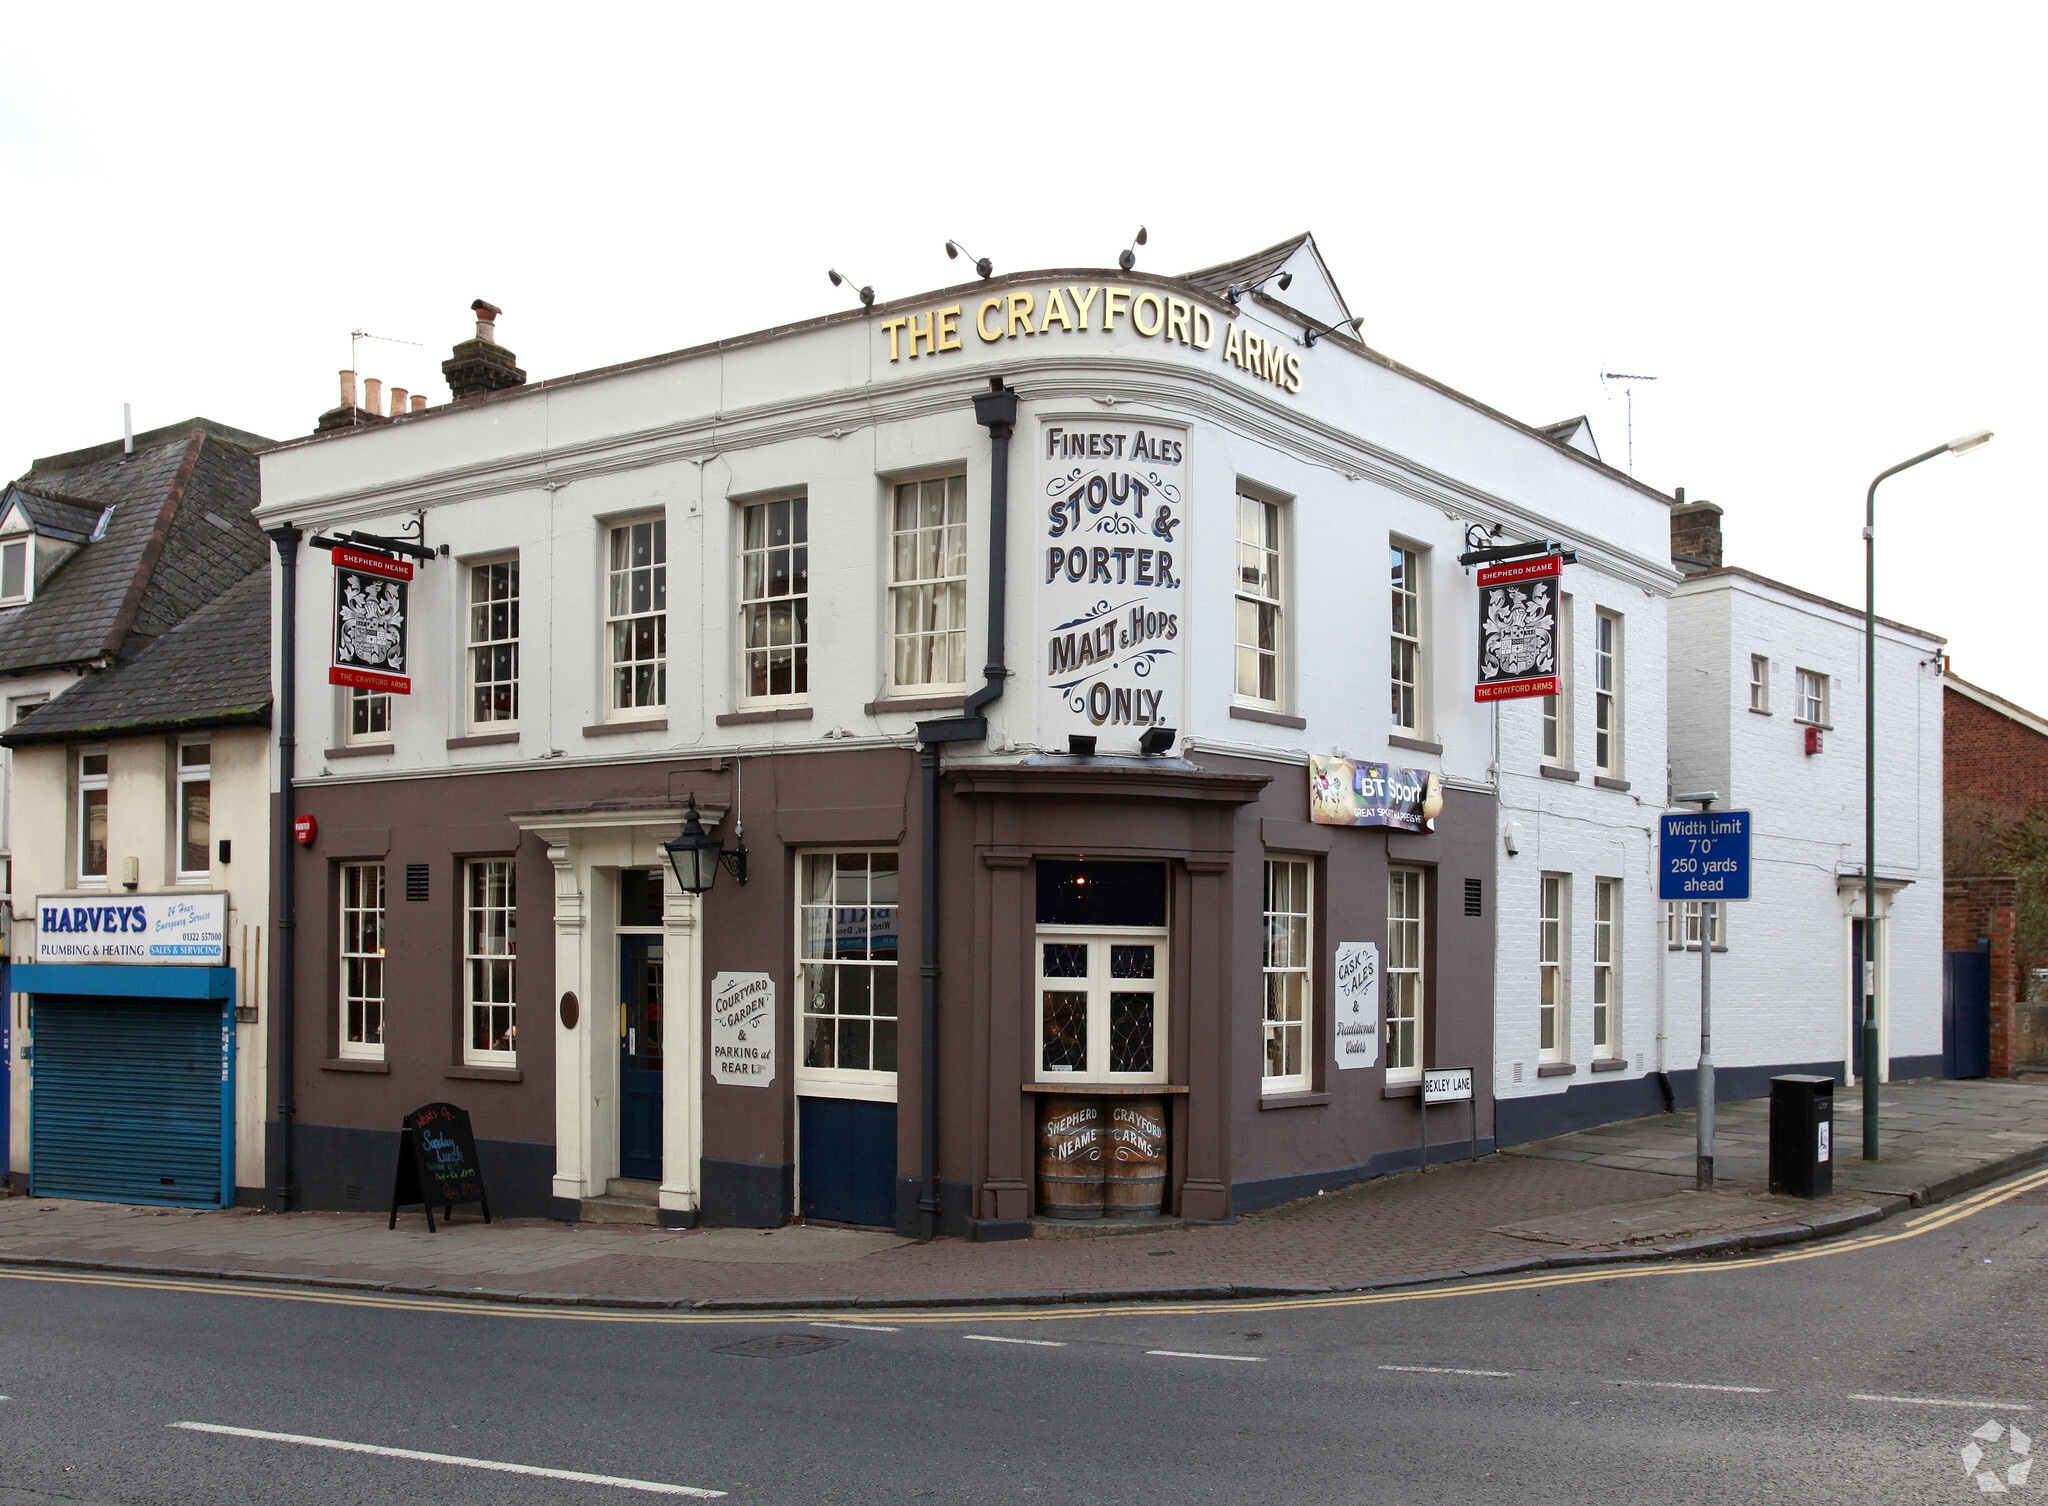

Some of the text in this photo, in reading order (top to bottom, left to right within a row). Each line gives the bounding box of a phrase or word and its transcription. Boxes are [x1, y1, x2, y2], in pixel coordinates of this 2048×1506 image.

[881, 285, 1303, 394] THE CRAYFORD ARMS
[1048, 472, 1181, 543] STOUT &
[343, 554, 409, 575] SHEPHERD NEAME
[1046, 545, 1181, 589] PORTER.
[1482, 563, 1553, 580] SHEPHERD NEAME
[1048, 618, 1118, 676] MALT
[1129, 605, 1178, 648] HOPS
[340, 672, 408, 690] THE CRAYFORD ARMS
[1477, 681, 1553, 697] THE CRAYFORD ARMS
[1086, 681, 1166, 727] ONLY.
[1361, 777, 1422, 804] BT Sport
[1353, 807, 1376, 818] GREAT
[1668, 819, 1742, 836] Width limit
[1671, 857, 1738, 876] 250 yards
[1683, 877, 1724, 891] ahead
[42, 905, 148, 933] HARVEYS
[167, 903, 194, 917] 24 Hour
[155, 911, 211, 933] Emergency Service
[182, 932, 222, 941] 01322 557000
[41, 944, 145, 956] PLUMBING & HEATING
[150, 944, 221, 955] SALES & SERVICING
[1338, 953, 1362, 980] CASK
[1350, 962, 1374, 992] ALES
[715, 979, 768, 1013] COURTYARD
[727, 996, 765, 1027] GARDEN
[1352, 1000, 1359, 1013] &
[737, 1029, 746, 1041] &
[1336, 1020, 1376, 1037] Traditional
[714, 1046, 771, 1060] PARKING at
[1345, 1040, 1366, 1055] Ciders
[721, 1062, 748, 1074] REAR
[1425, 1077, 1470, 1093] BEXLEY LANE
[1047, 1108, 1098, 1137] SHEPHERD
[1113, 1108, 1162, 1139] CRAYFORD
[423, 1130, 455, 1151] Sunday
[1058, 1129, 1097, 1160] NEAME
[1122, 1130, 1153, 1157] ARMS
